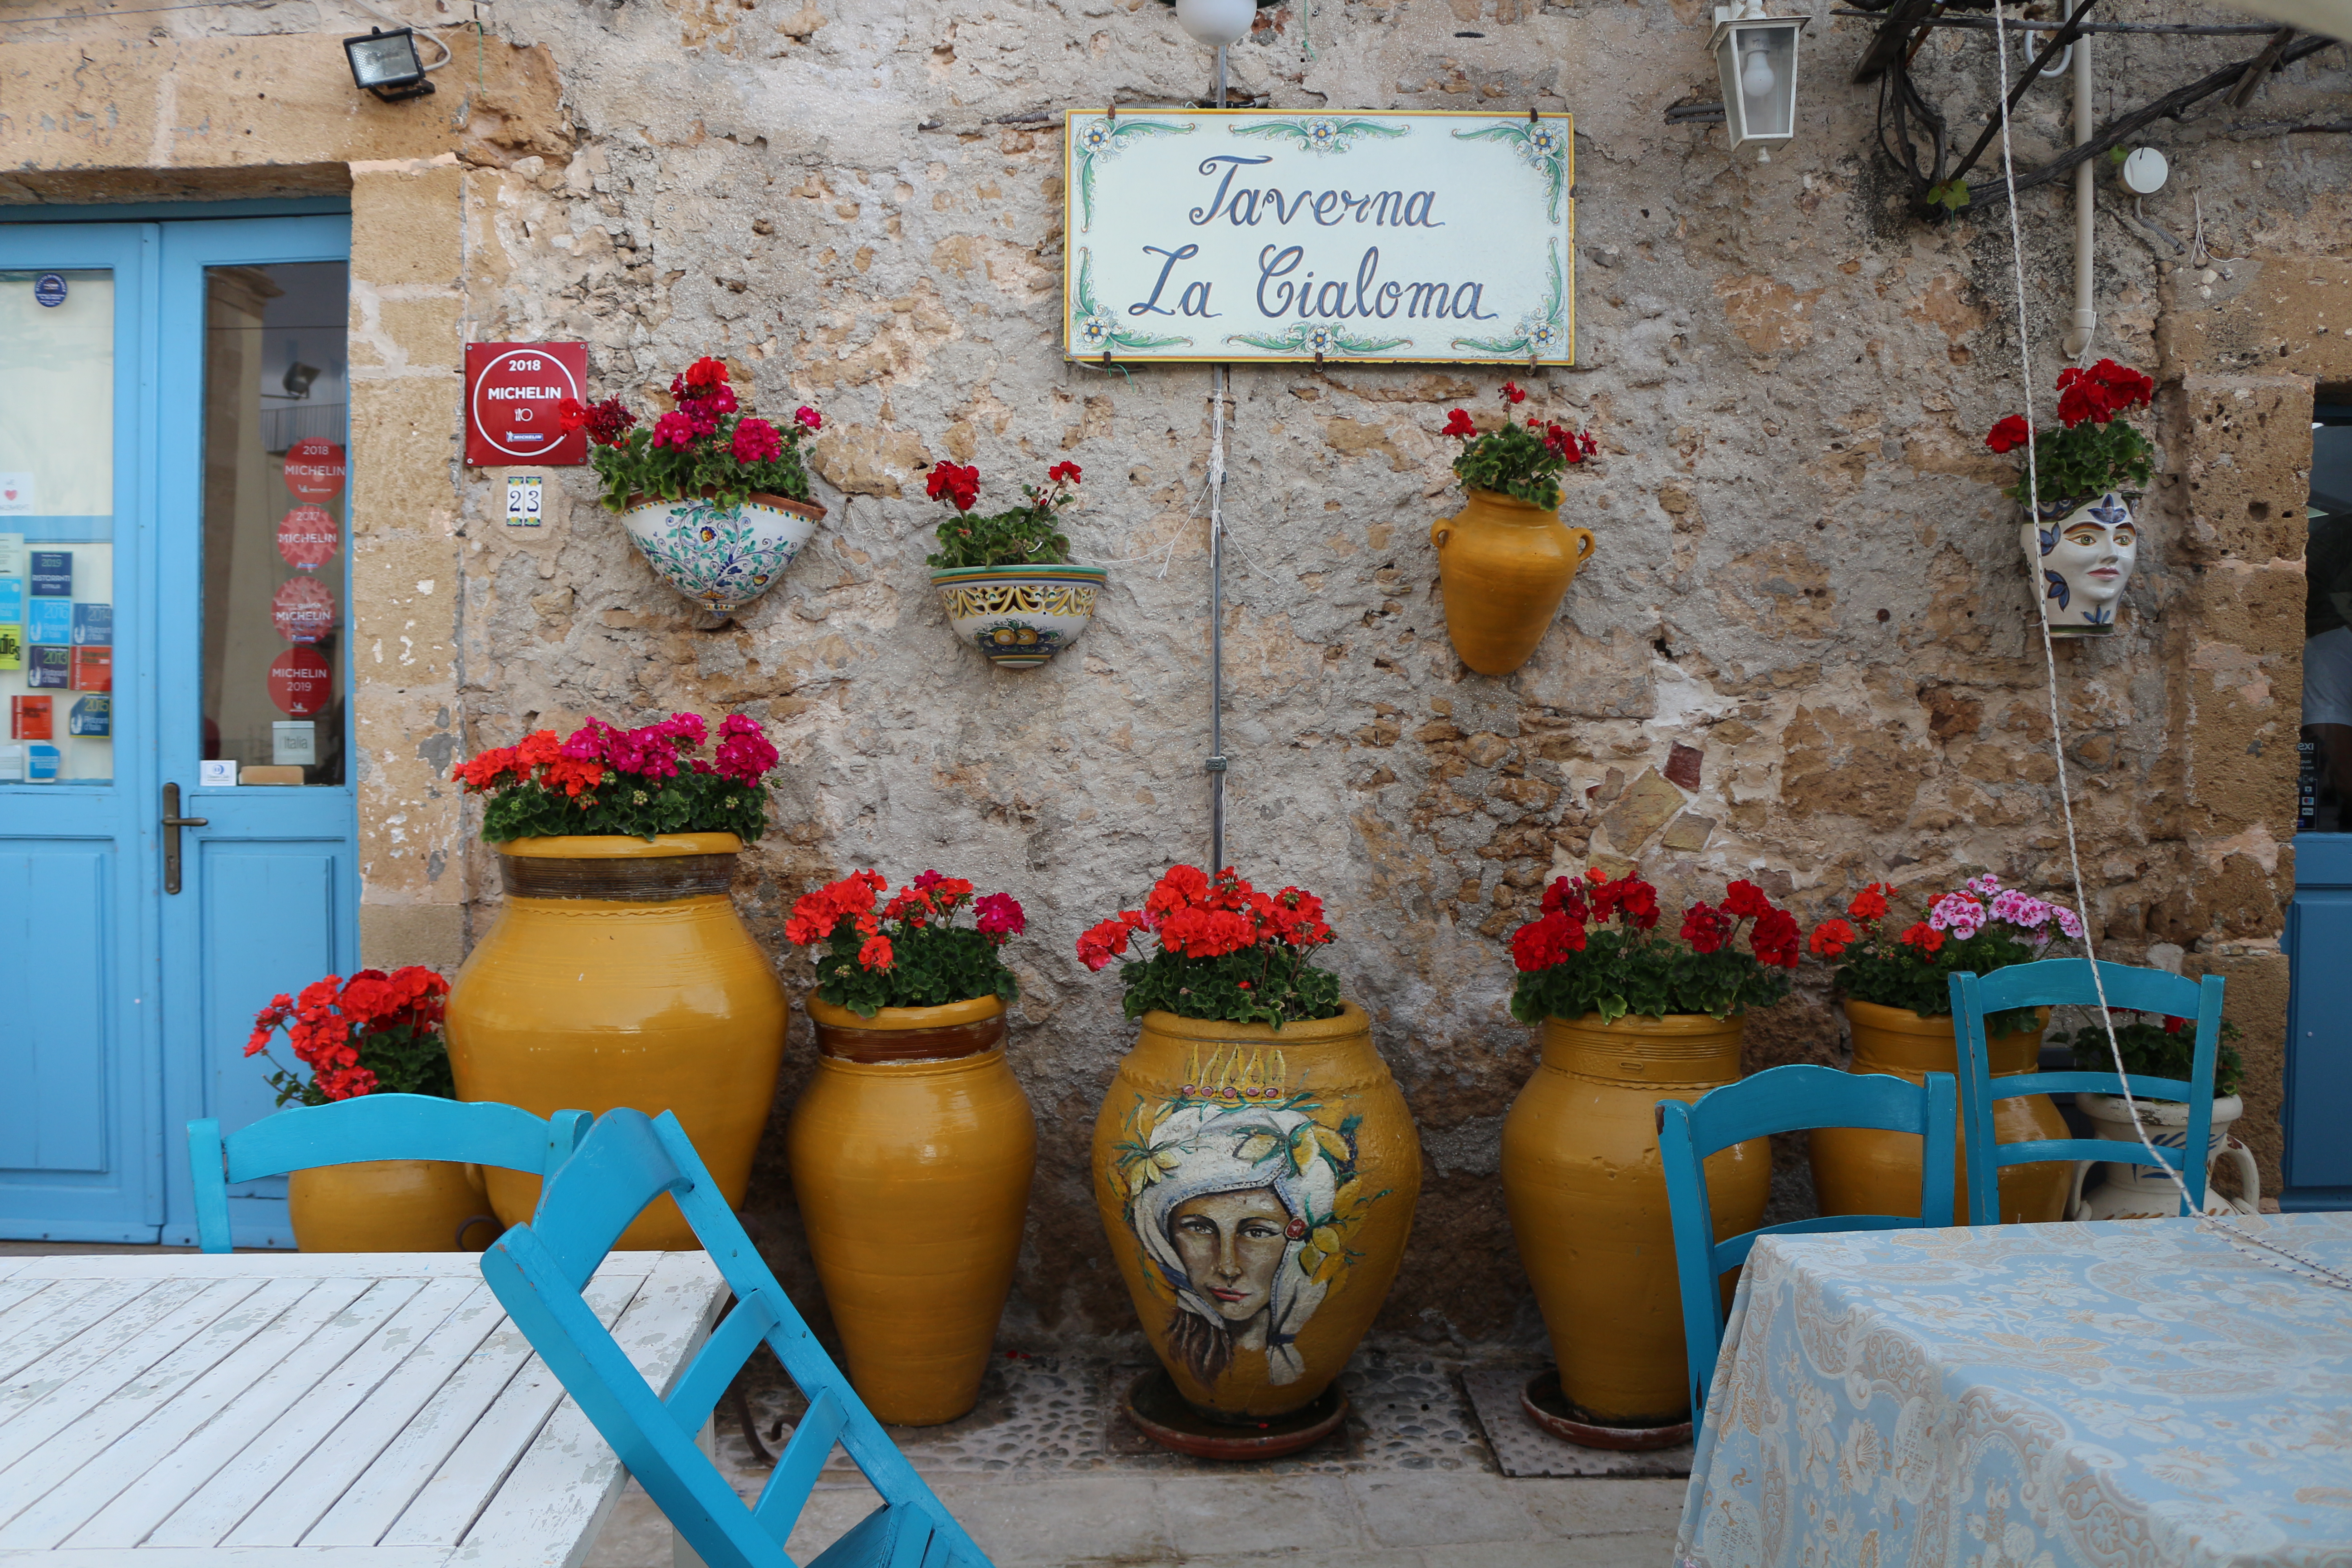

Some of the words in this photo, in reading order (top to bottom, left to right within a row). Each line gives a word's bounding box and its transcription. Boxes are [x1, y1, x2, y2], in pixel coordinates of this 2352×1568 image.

[1189, 154, 1446, 227] Taverna
[1128, 243, 1222, 318] La
[1255, 244, 1499, 320] Cialoma
[508, 360, 541, 372] 2018
[488, 387, 562, 400] MICHELIN
[302, 446, 329, 456] 2018
[284, 465, 345, 476] MICHELIN
[510, 490, 539, 512] 23
[296, 511, 320, 521] 2017
[278, 533, 337, 544] MICHELIN
[275, 611, 331, 621] MICHELIN
[44, 650, 67, 664] 2013
[272, 668, 327, 678] MICHELIN
[286, 681, 312, 692] 2019
[84, 699, 108, 712] 2015
